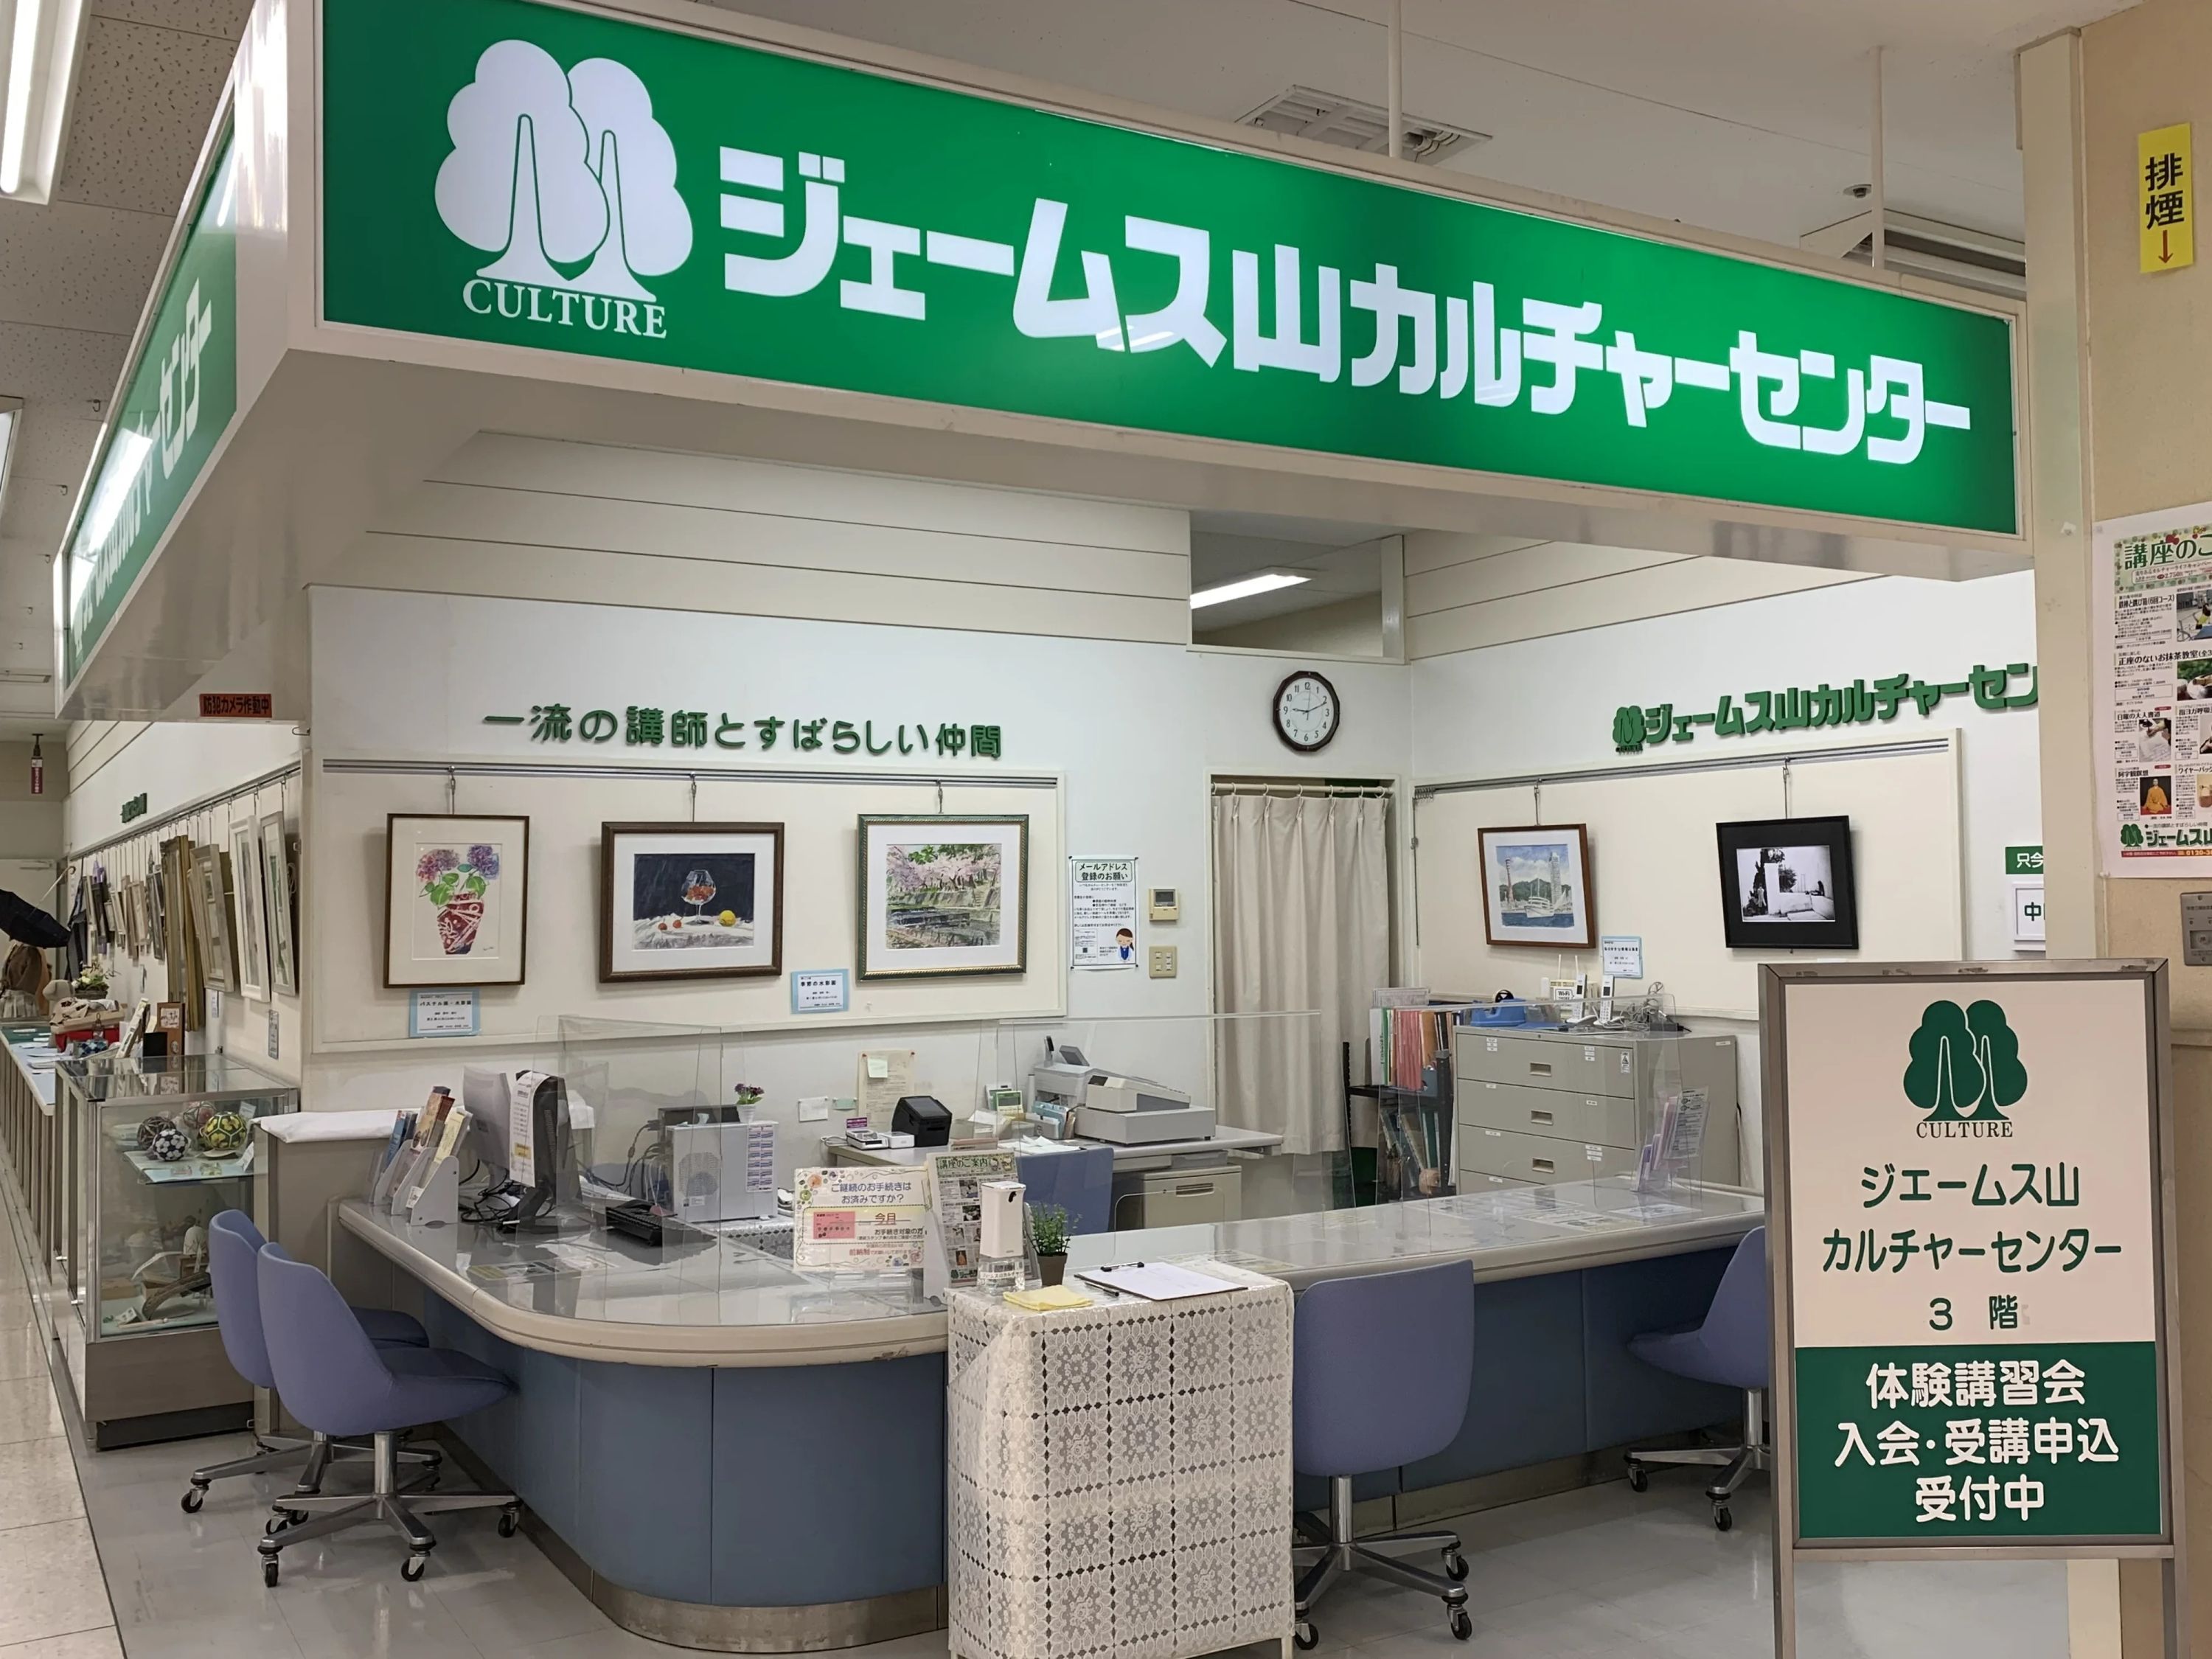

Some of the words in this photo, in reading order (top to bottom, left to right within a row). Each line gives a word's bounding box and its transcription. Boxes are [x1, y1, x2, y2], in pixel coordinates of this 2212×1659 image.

[2144, 153, 2185, 230] 排煙
[462, 278, 667, 339] CULTURE
[720, 145, 1970, 465] ジェームス山カルチャーセンター
[203, 695, 269, 714] 防犯カメラ作動中
[1283, 706, 1288, 714] 9
[1325, 709, 1329, 717] 3
[484, 702, 1002, 759] 一流の講師とすばらしい仲間
[1286, 720, 1290, 728] 8
[1293, 729, 1298, 737] 7
[1304, 734, 1309, 742] 6
[1079, 863, 1128, 871] メールアドレス
[1081, 872, 1129, 881] 登録のお願い
[2024, 902, 2045, 922] 中
[1916, 1121, 2014, 1138] CULTURE
[831, 1182, 912, 1193] ご継続のお手続きは
[874, 1212, 897, 1225] 今月
[1823, 1228, 2122, 1273] カルチャーセンター
[1930, 1298, 1952, 1331] 3
[1989, 1295, 2018, 1329] 階
[1865, 1359, 2086, 1409] 体験講習会
[1834, 1417, 2120, 1467] 入会・受講申込
[1916, 1474, 2045, 1523] 受付中
